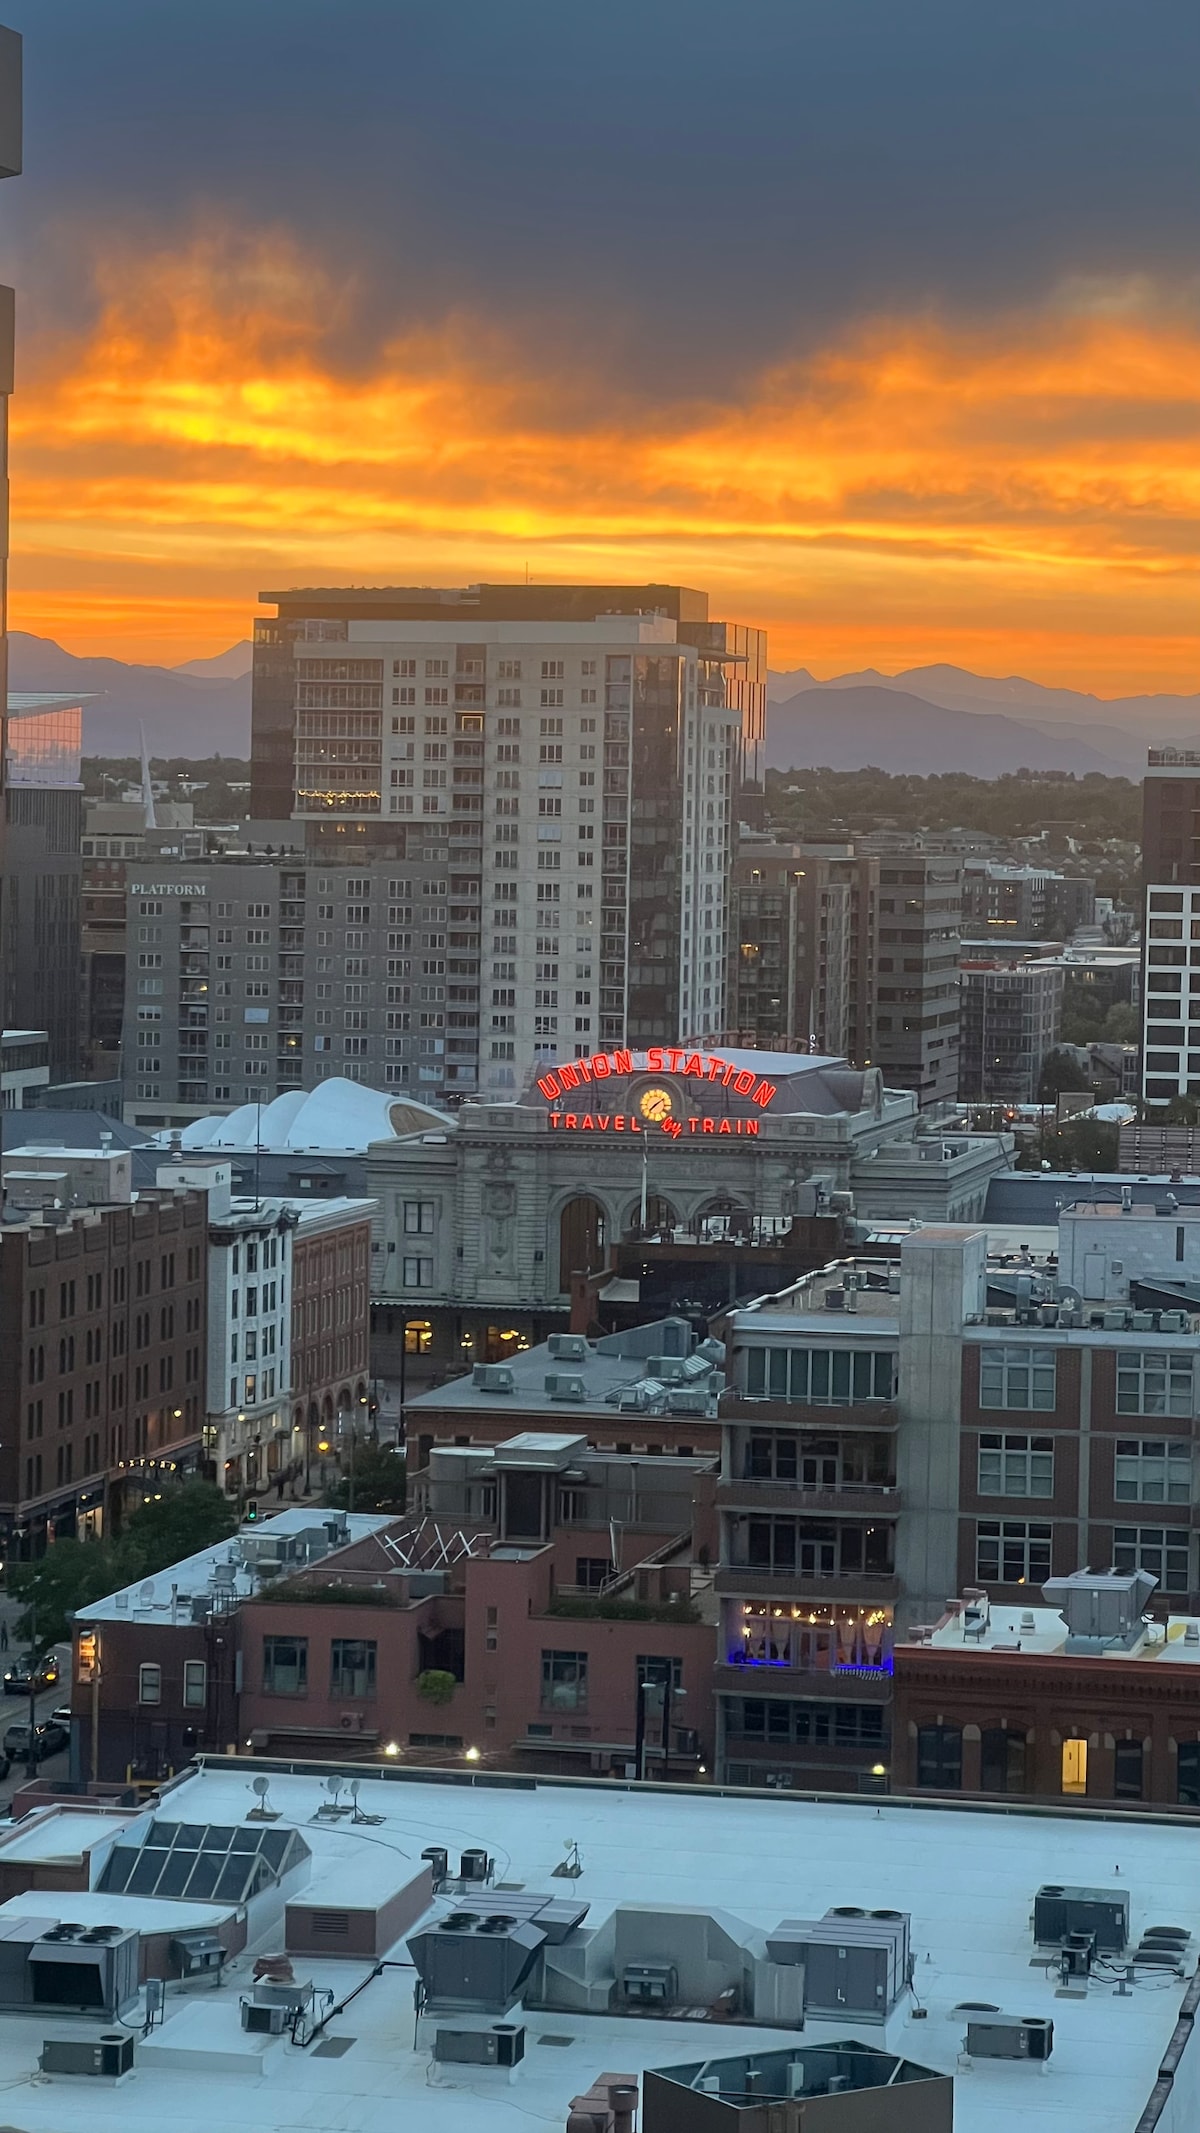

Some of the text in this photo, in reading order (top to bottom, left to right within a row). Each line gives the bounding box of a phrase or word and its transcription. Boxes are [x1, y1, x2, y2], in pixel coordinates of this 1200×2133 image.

[131, 884, 206, 896] PLATFORM
[537, 1047, 777, 1108] UNION STATION
[549, 1113, 759, 1139] TRAVEL by TRAIN
